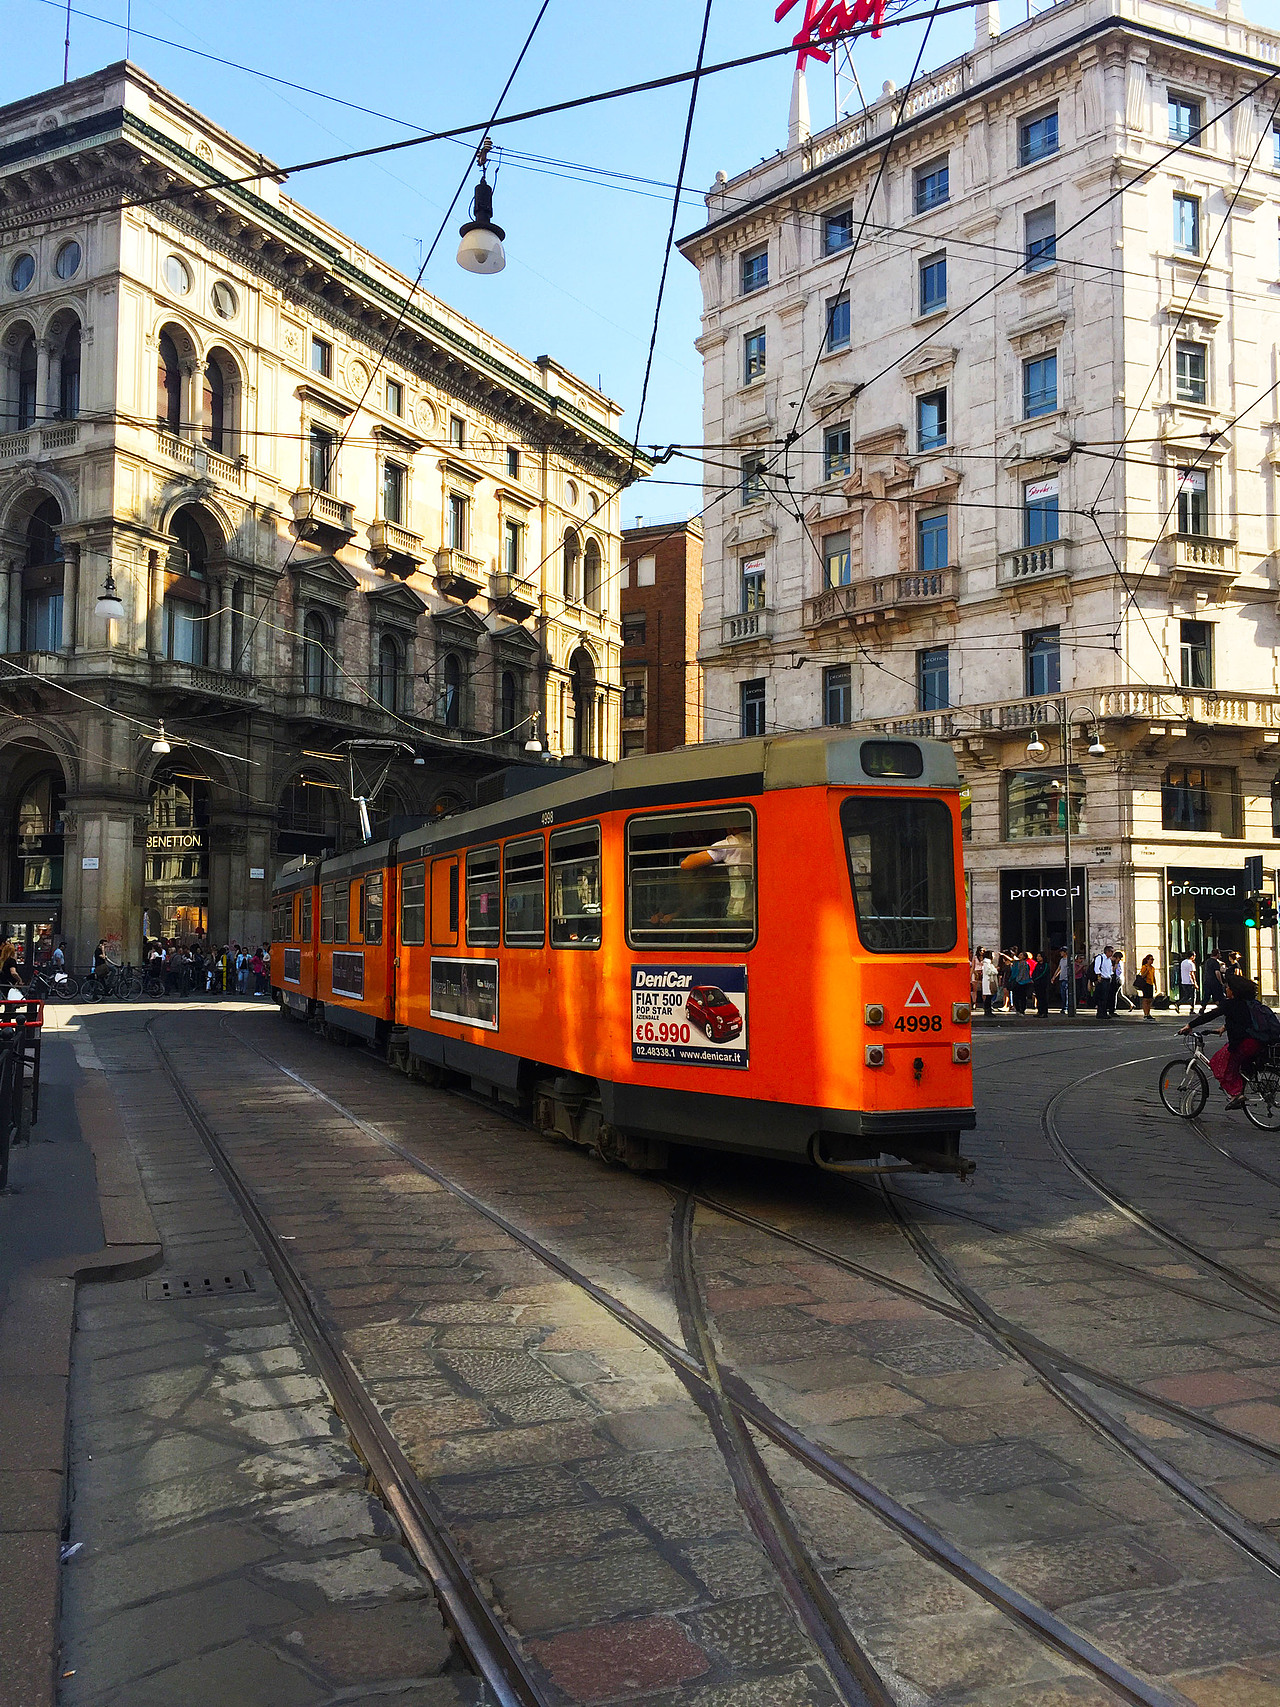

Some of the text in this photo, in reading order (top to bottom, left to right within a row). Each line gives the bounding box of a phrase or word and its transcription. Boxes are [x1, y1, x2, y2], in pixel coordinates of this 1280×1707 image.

[1010, 885, 1080, 900] promod
[1171, 885, 1236, 897] promod
[635, 970, 693, 988] DeniCar
[636, 992, 683, 1007] FIAT 500
[636, 1005, 673, 1016] POP STAR
[894, 1015, 943, 1032] 4998
[635, 1021, 691, 1044] €6.990
[636, 1046, 741, 1063] 02.48338.1 www.denicar.it
